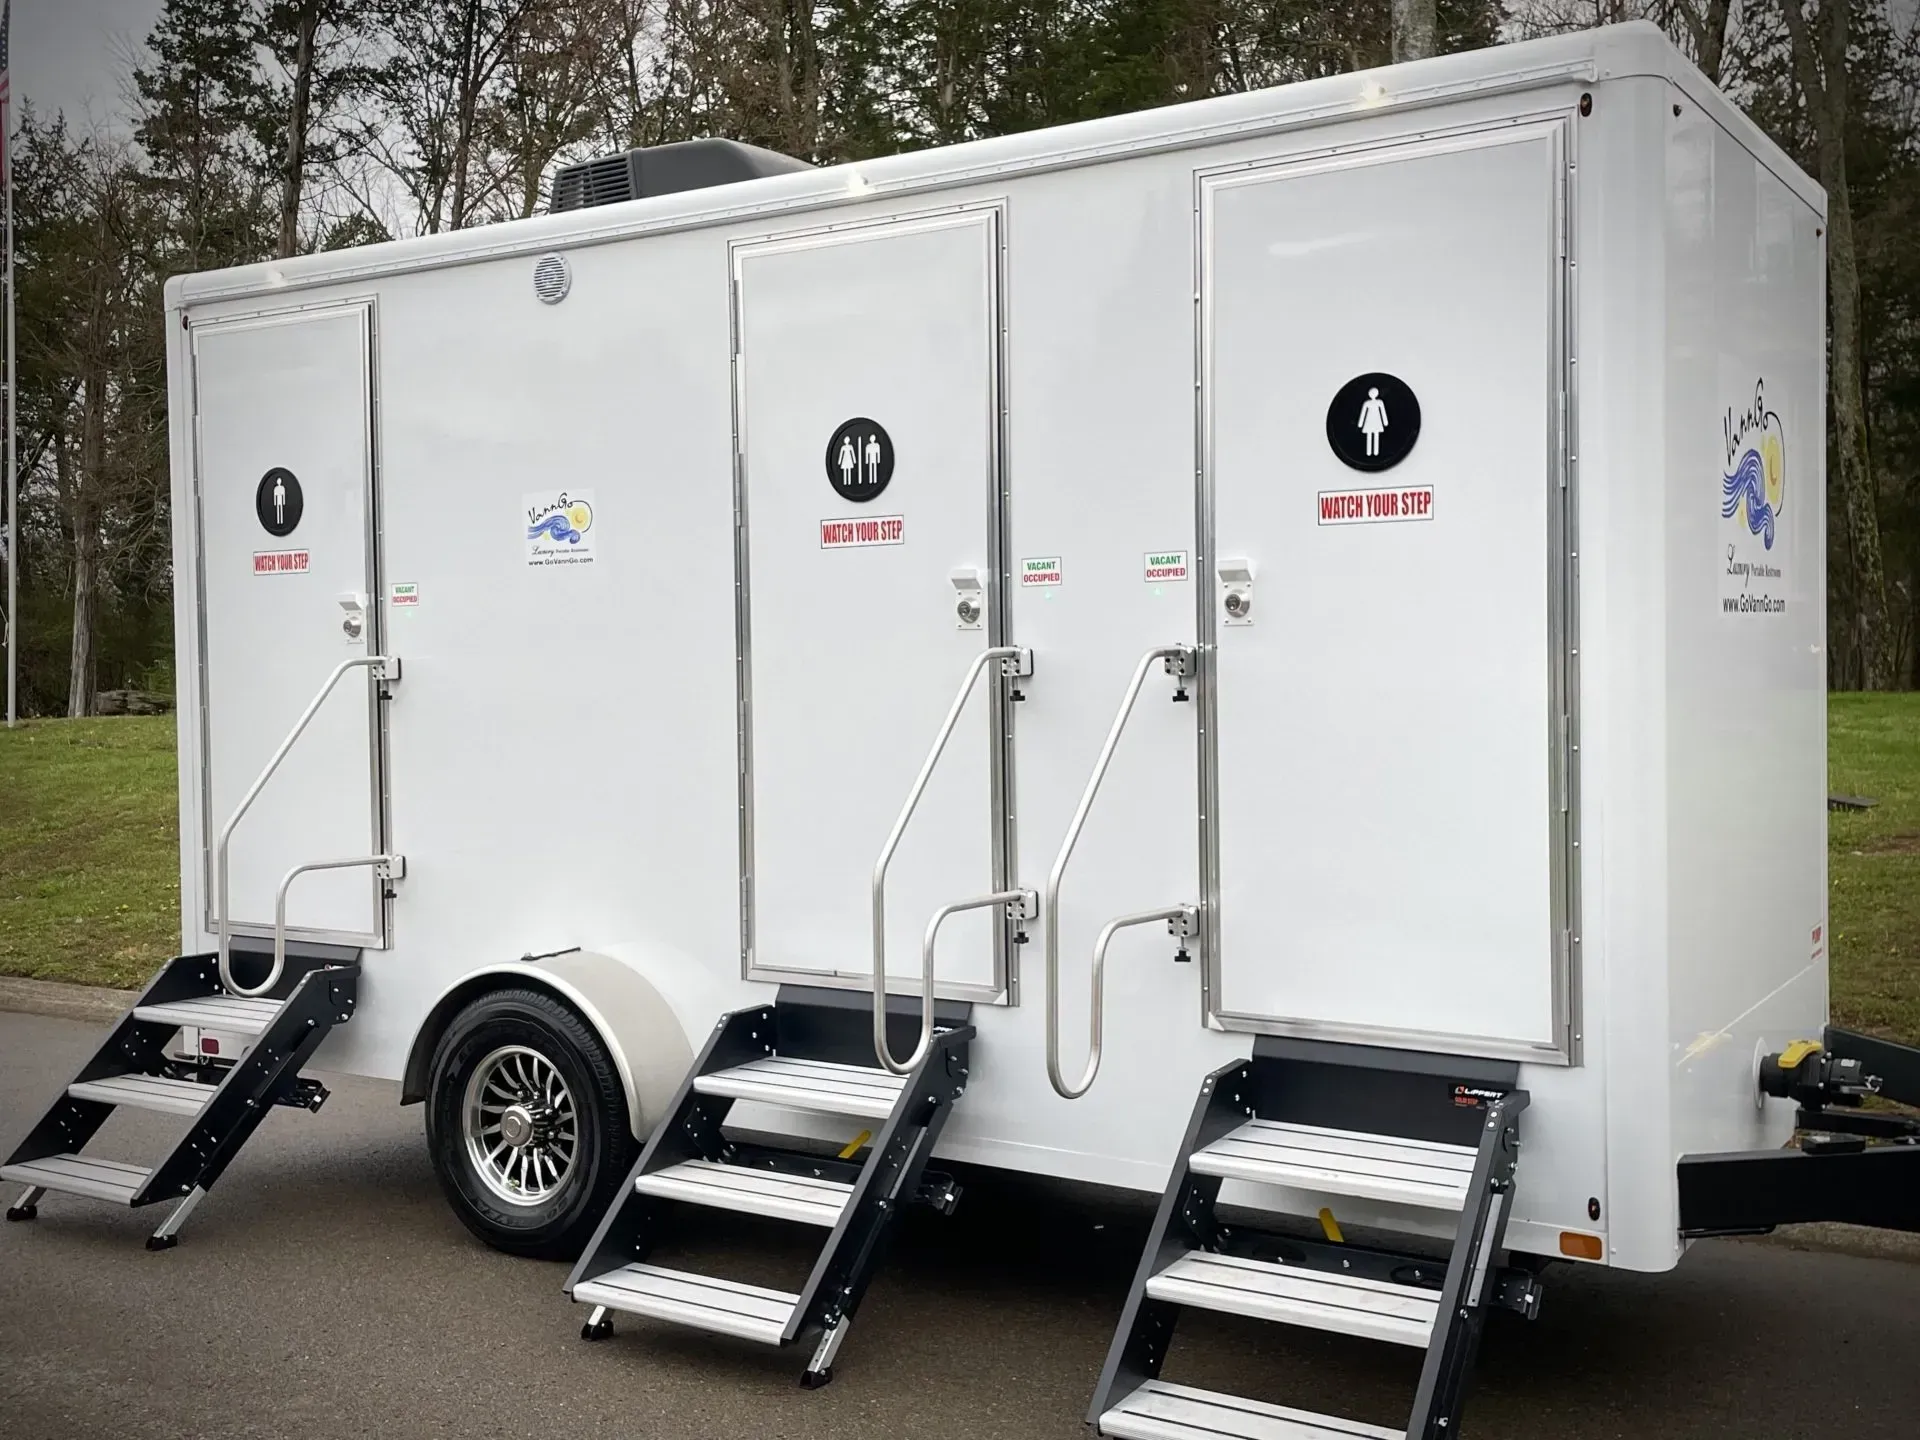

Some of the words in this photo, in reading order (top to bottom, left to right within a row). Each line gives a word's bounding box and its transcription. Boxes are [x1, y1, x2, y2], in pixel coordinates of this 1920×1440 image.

[1723, 377, 1772, 467] VannGo
[528, 492, 575, 524] VannGo
[1321, 495, 1363, 519] WATCH
[1366, 493, 1398, 517] YOUR
[1401, 491, 1431, 515] STEP
[823, 523, 853, 543] WATCH
[856, 522, 879, 542] YOUR
[880, 520, 902, 540] STEP
[254, 555, 276, 571] WATCH
[277, 554, 293, 571] YOUR
[293, 553, 308, 570] STEP
[528, 557, 594, 566] www.GoVannGo.com
[1027, 561, 1056, 571] VACANT
[1150, 555, 1181, 566] VACANT
[1023, 573, 1060, 583] OCCUPIED
[1146, 567, 1186, 578] OCCUPIED
[392, 595, 417, 604] OCCUPIED
[1723, 593, 1786, 613] www.GoVannGo.com
[1464, 1087, 1503, 1099] LIPPERT
